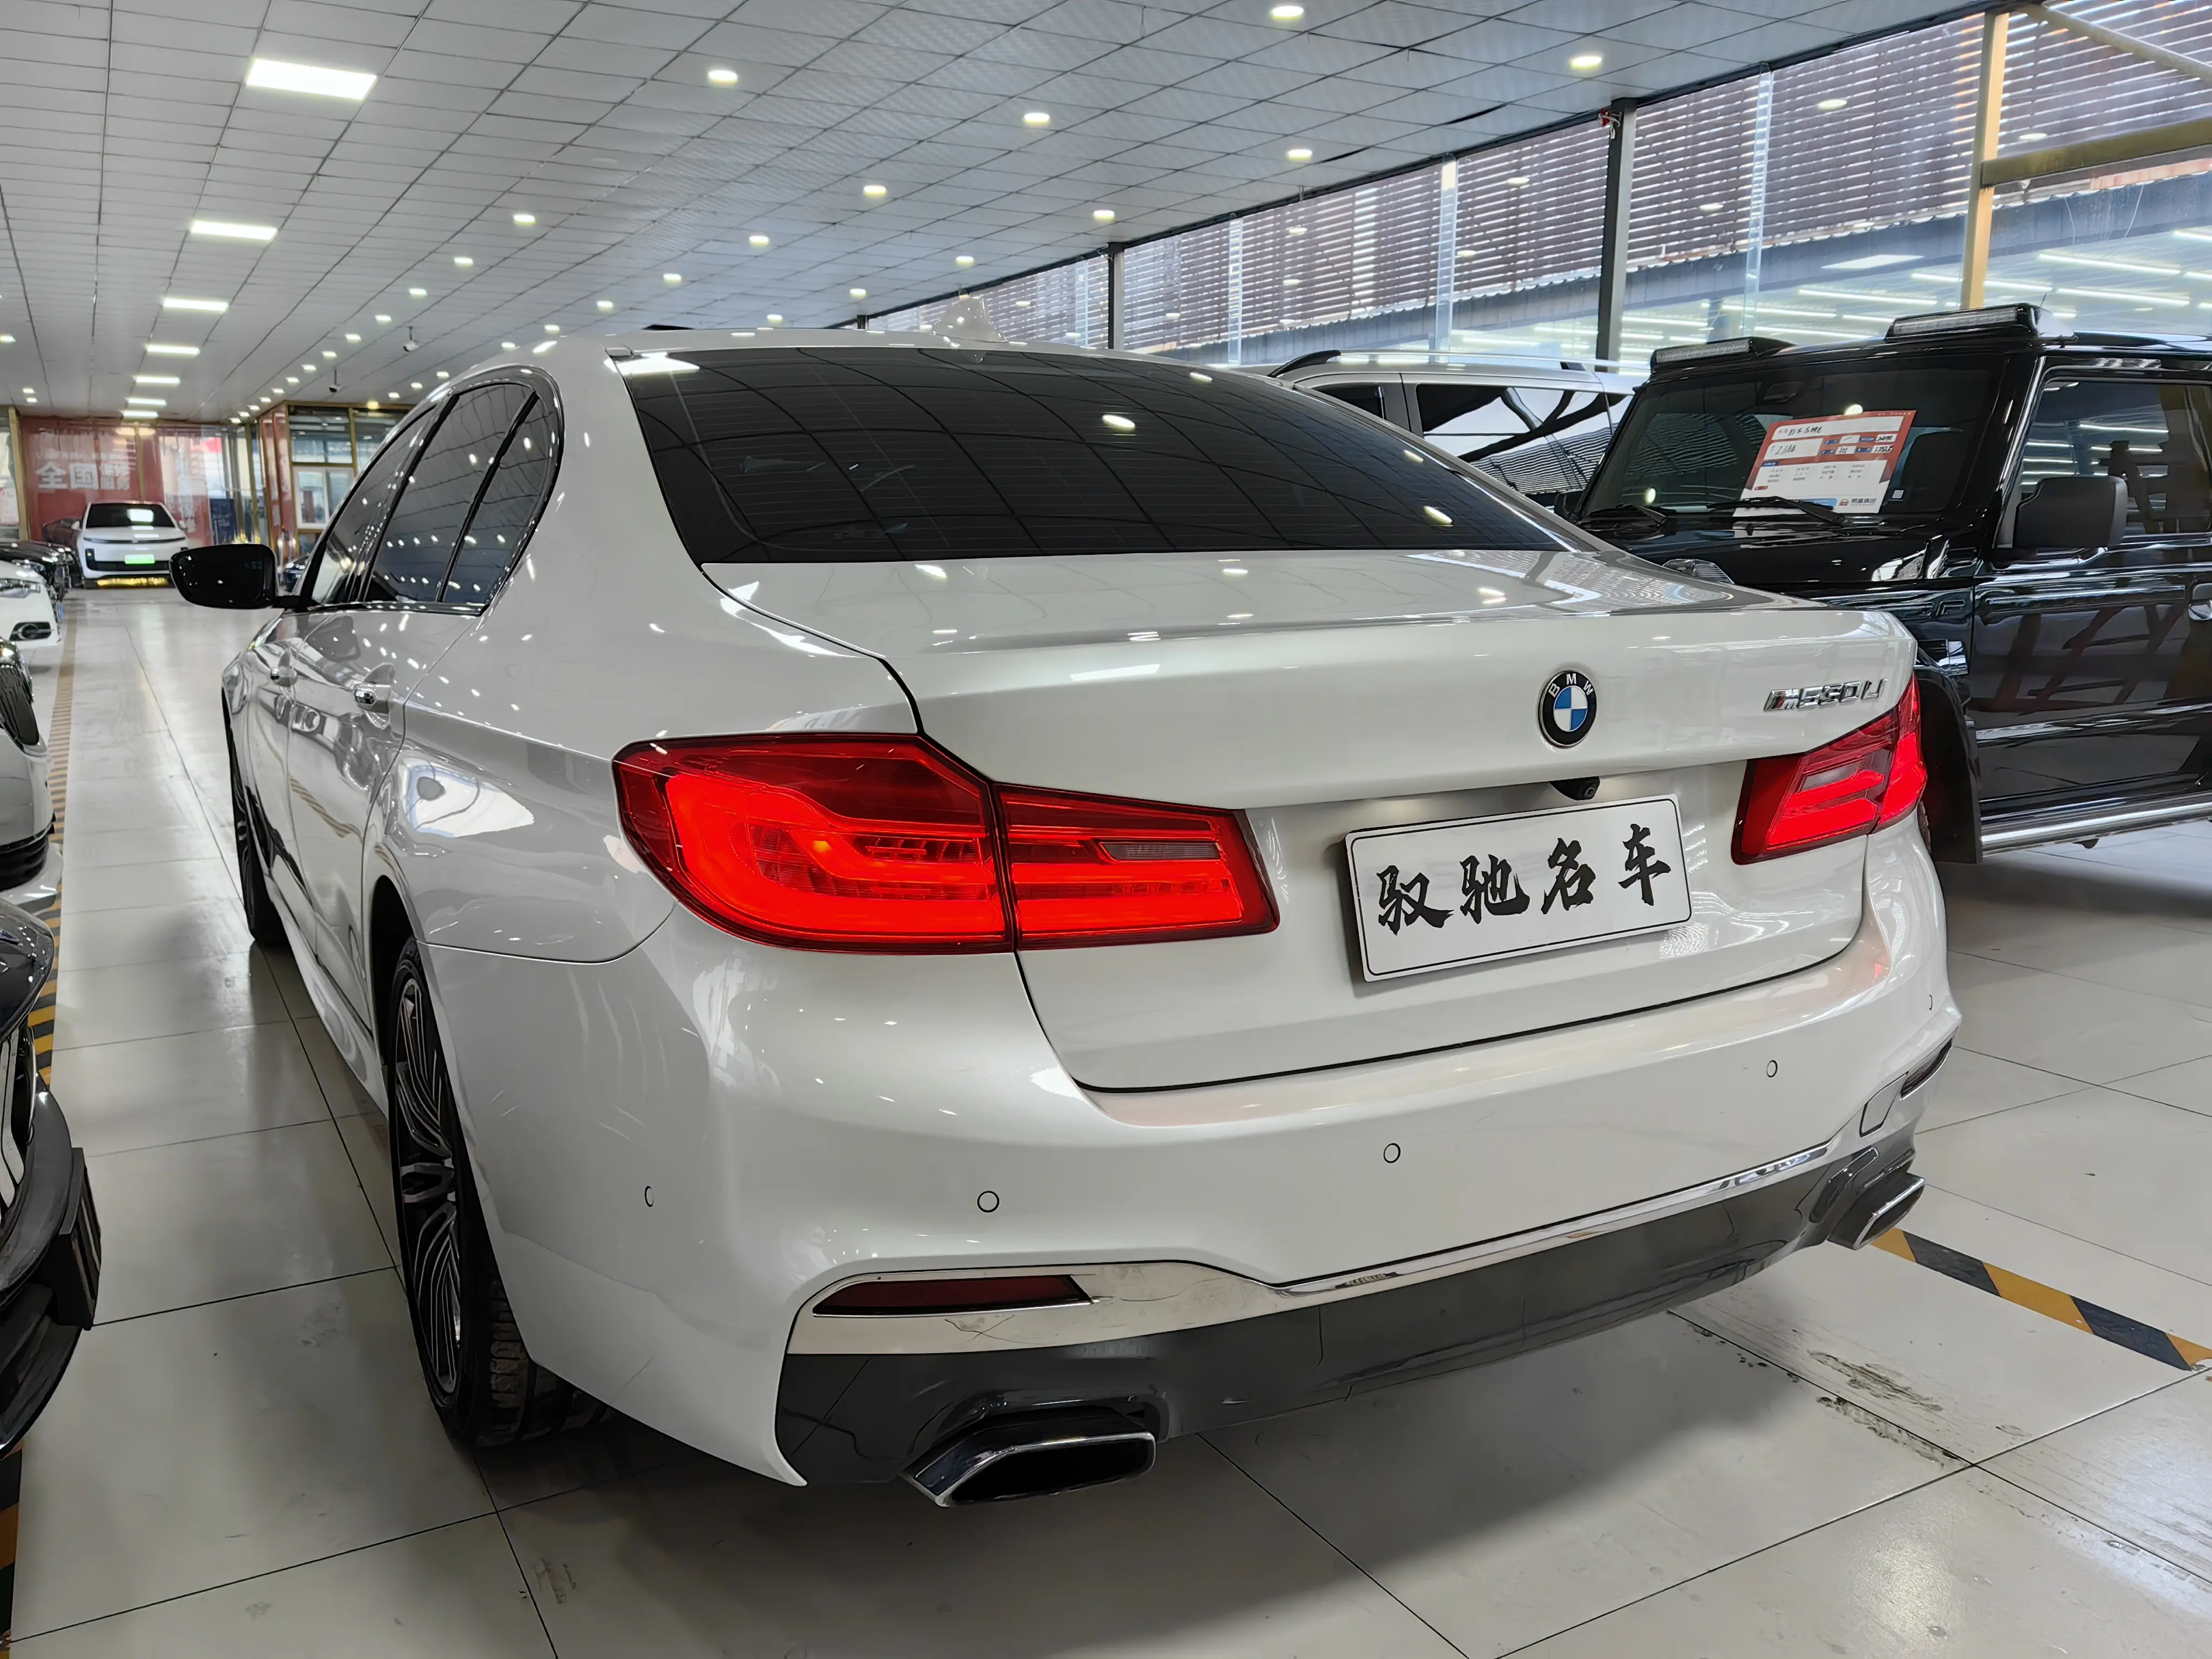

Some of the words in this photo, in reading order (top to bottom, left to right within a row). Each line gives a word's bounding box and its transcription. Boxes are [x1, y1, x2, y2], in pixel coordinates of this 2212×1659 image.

[1548, 673, 1593, 698] BMW
[1376, 823, 1671, 936] 驭驰名车
